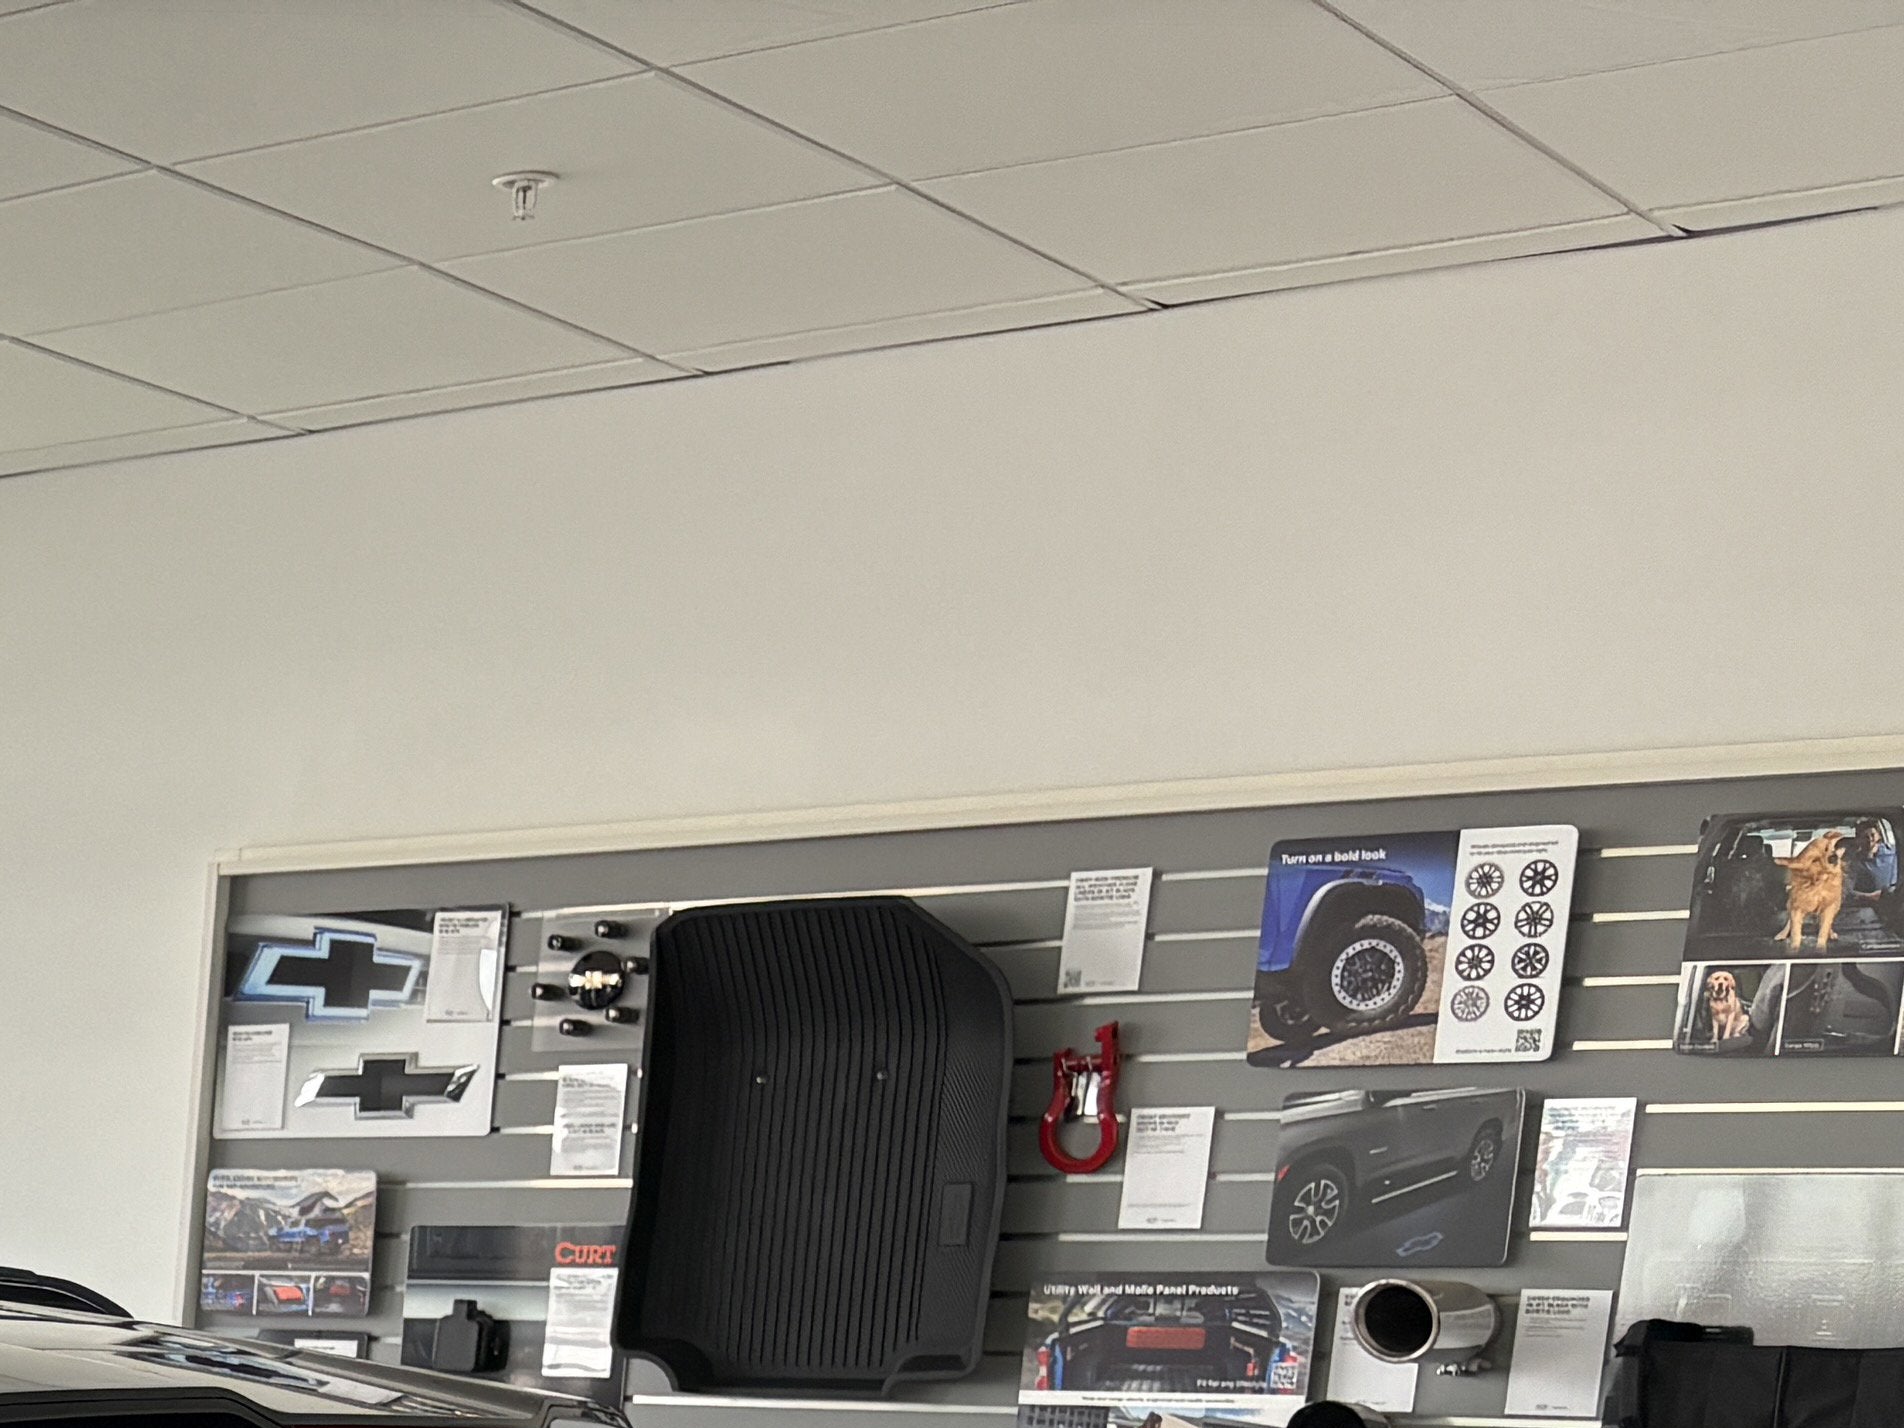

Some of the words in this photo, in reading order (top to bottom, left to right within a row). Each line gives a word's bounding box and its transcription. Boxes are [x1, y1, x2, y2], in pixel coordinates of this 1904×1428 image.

[1281, 854, 1307, 864] Turn
[1308, 853, 1323, 863] on
[1325, 854, 1332, 862] a
[1334, 850, 1359, 862] bold
[1361, 848, 1386, 860] look
[554, 1241, 617, 1265] CURT
[1043, 1285, 1075, 1295] Utility
[1078, 1285, 1101, 1294] Wall
[1102, 1285, 1121, 1294] and
[1156, 1285, 1186, 1295] Panel
[1188, 1285, 1239, 1295] Products
